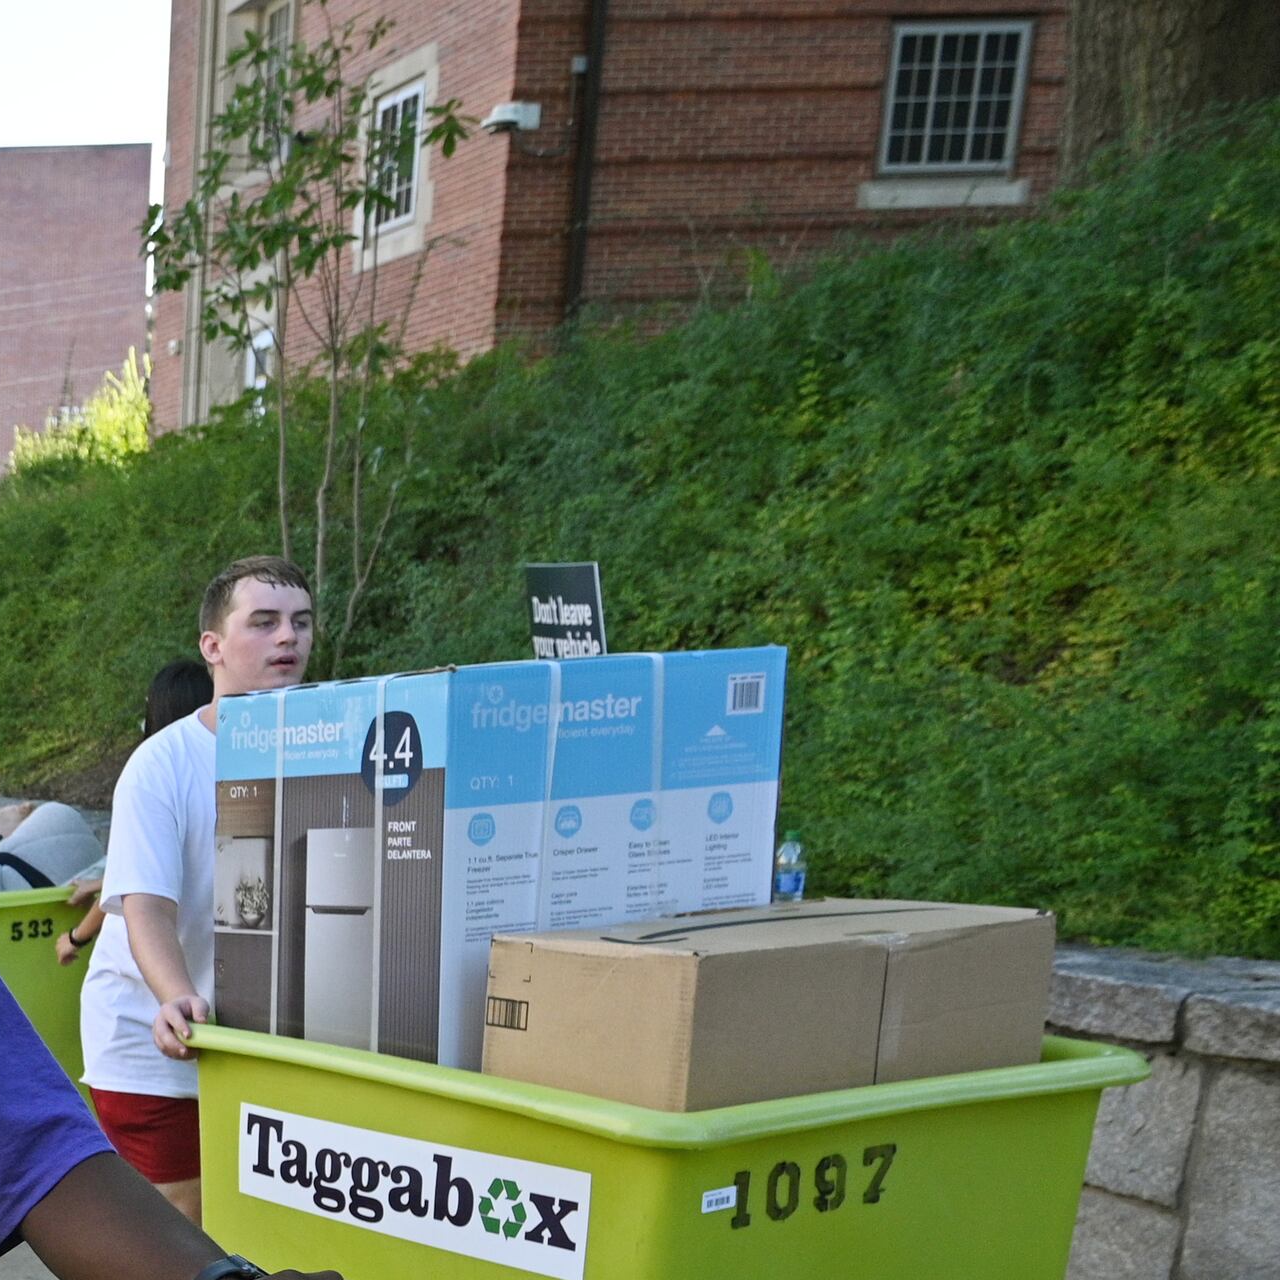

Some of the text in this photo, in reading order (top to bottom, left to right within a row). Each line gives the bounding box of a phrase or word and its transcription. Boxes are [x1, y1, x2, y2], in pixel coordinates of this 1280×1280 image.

[558, 595, 592, 626] leave
[532, 630, 601, 660] your vehicle
[369, 726, 414, 768] 4.4
[470, 775, 513, 790] QTY: 1
[230, 786, 258, 799] QTY: 1
[388, 821, 417, 832] FRONT
[388, 836, 412, 847] PARTE
[387, 849, 432, 860] DELANTERA
[11, 919, 54, 941] 533
[731, 1143, 897, 1230] 1097
